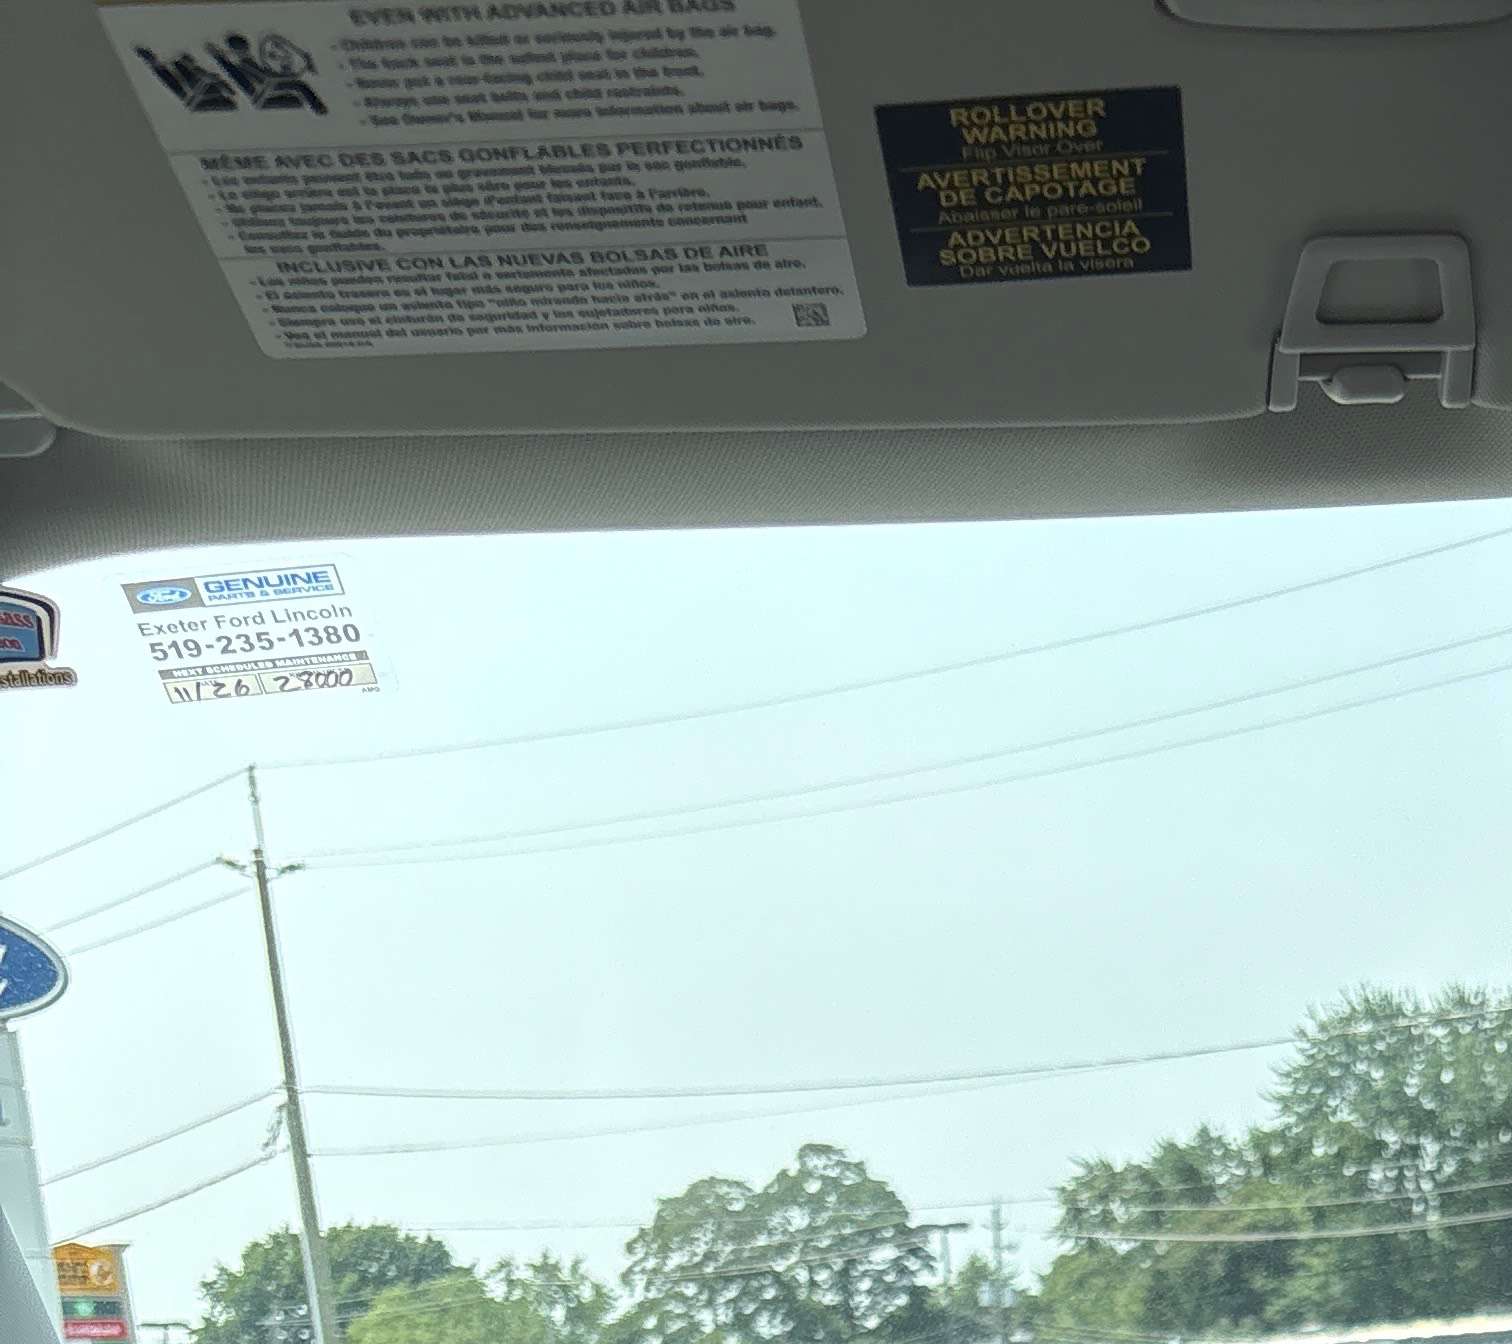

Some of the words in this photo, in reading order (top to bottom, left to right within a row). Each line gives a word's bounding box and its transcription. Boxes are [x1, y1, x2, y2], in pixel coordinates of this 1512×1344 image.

[949, 98, 1107, 128] ROLLOVER
[961, 120, 1097, 144] WARNING
[275, 152, 334, 168] AVEC
[337, 151, 386, 167] DES
[390, 147, 453, 165] SACS
[458, 143, 611, 163] GONFLABLES
[616, 134, 804, 156] PERFECTIONNÉS
[916, 158, 1146, 192] AVERTISSEMENT
[938, 190, 976, 209] DE
[985, 178, 1136, 204] CAPOTAGE
[947, 219, 1142, 249] ADVERTENCIA
[276, 258, 390, 275] INCLUSIVE
[395, 256, 444, 272] CON
[448, 254, 492, 269] LAS
[496, 251, 583, 267] NUEVAS
[590, 247, 678, 265] BOLSAS
[683, 245, 713, 260] DE
[719, 243, 769, 259] AIRE
[939, 243, 1033, 267] SOBRE
[1040, 235, 1152, 259] VUELCO
[203, 570, 331, 593] GENUINE
[137, 617, 208, 638] Exeter
[215, 610, 266, 631] Ford
[273, 603, 353, 624] Lincoln
[150, 623, 362, 663] 519-235-1380
